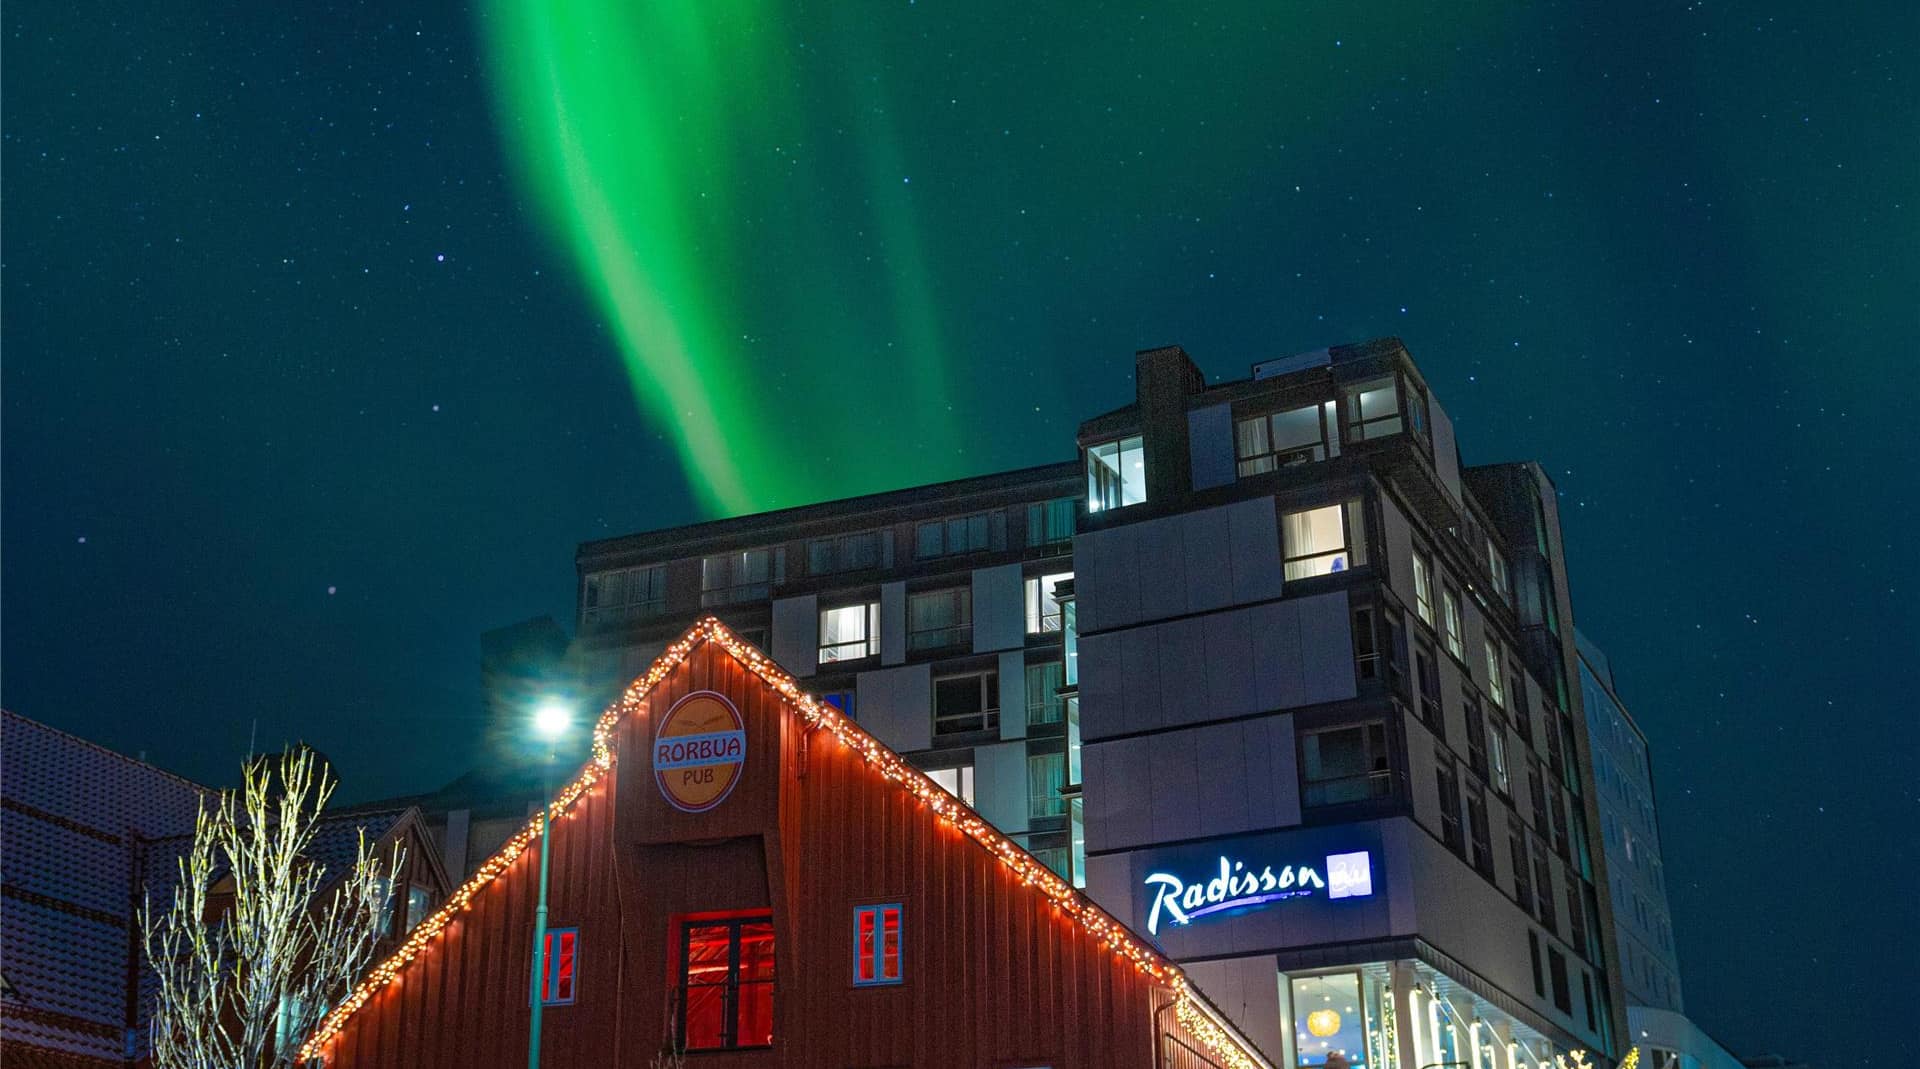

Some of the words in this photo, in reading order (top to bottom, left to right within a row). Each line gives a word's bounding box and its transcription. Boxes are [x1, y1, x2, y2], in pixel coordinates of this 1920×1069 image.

[658, 738, 741, 763] RORBUA
[683, 768, 714, 785] PUB
[1144, 856, 1325, 935] Radisson
